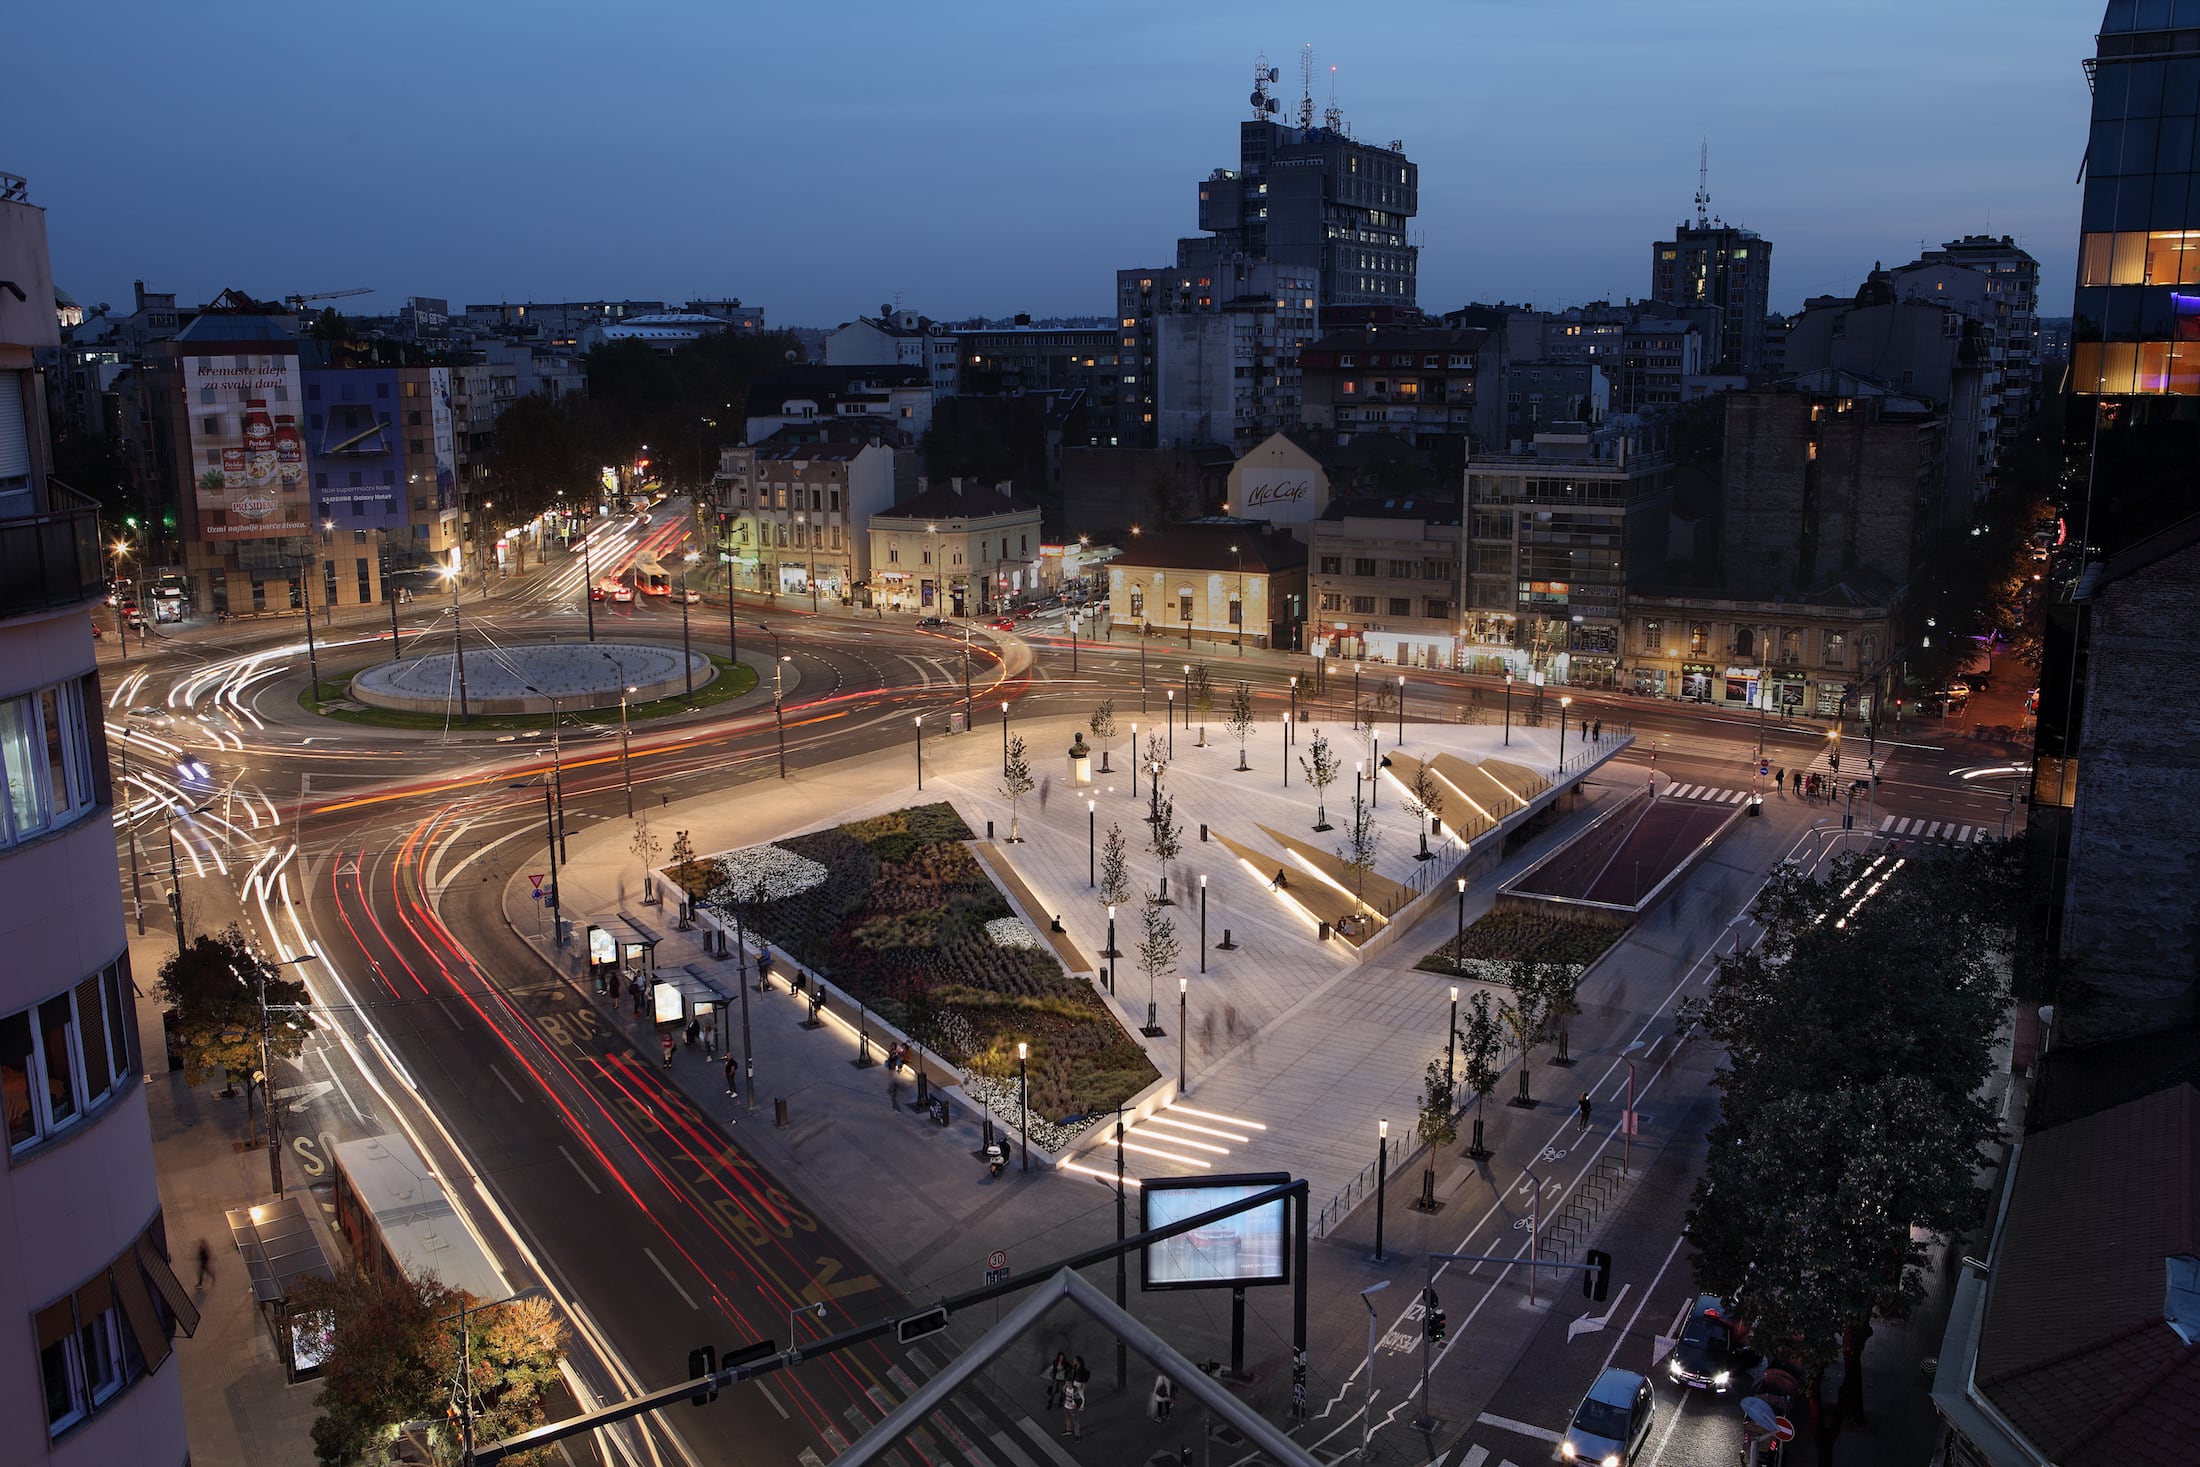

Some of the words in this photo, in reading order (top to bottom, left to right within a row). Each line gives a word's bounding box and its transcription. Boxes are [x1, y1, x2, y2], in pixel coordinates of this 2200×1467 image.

[198, 366, 255, 376] Kremaste
[259, 365, 287, 377] ideje
[221, 380, 252, 389] svaki
[255, 379, 282, 389] dan!
[228, 523, 258, 533] najbolje
[535, 1008, 612, 1047] BUS
[616, 1089, 703, 1134] BUS
[713, 1188, 817, 1247] BUS
[992, 1254, 1003, 1266] 30
